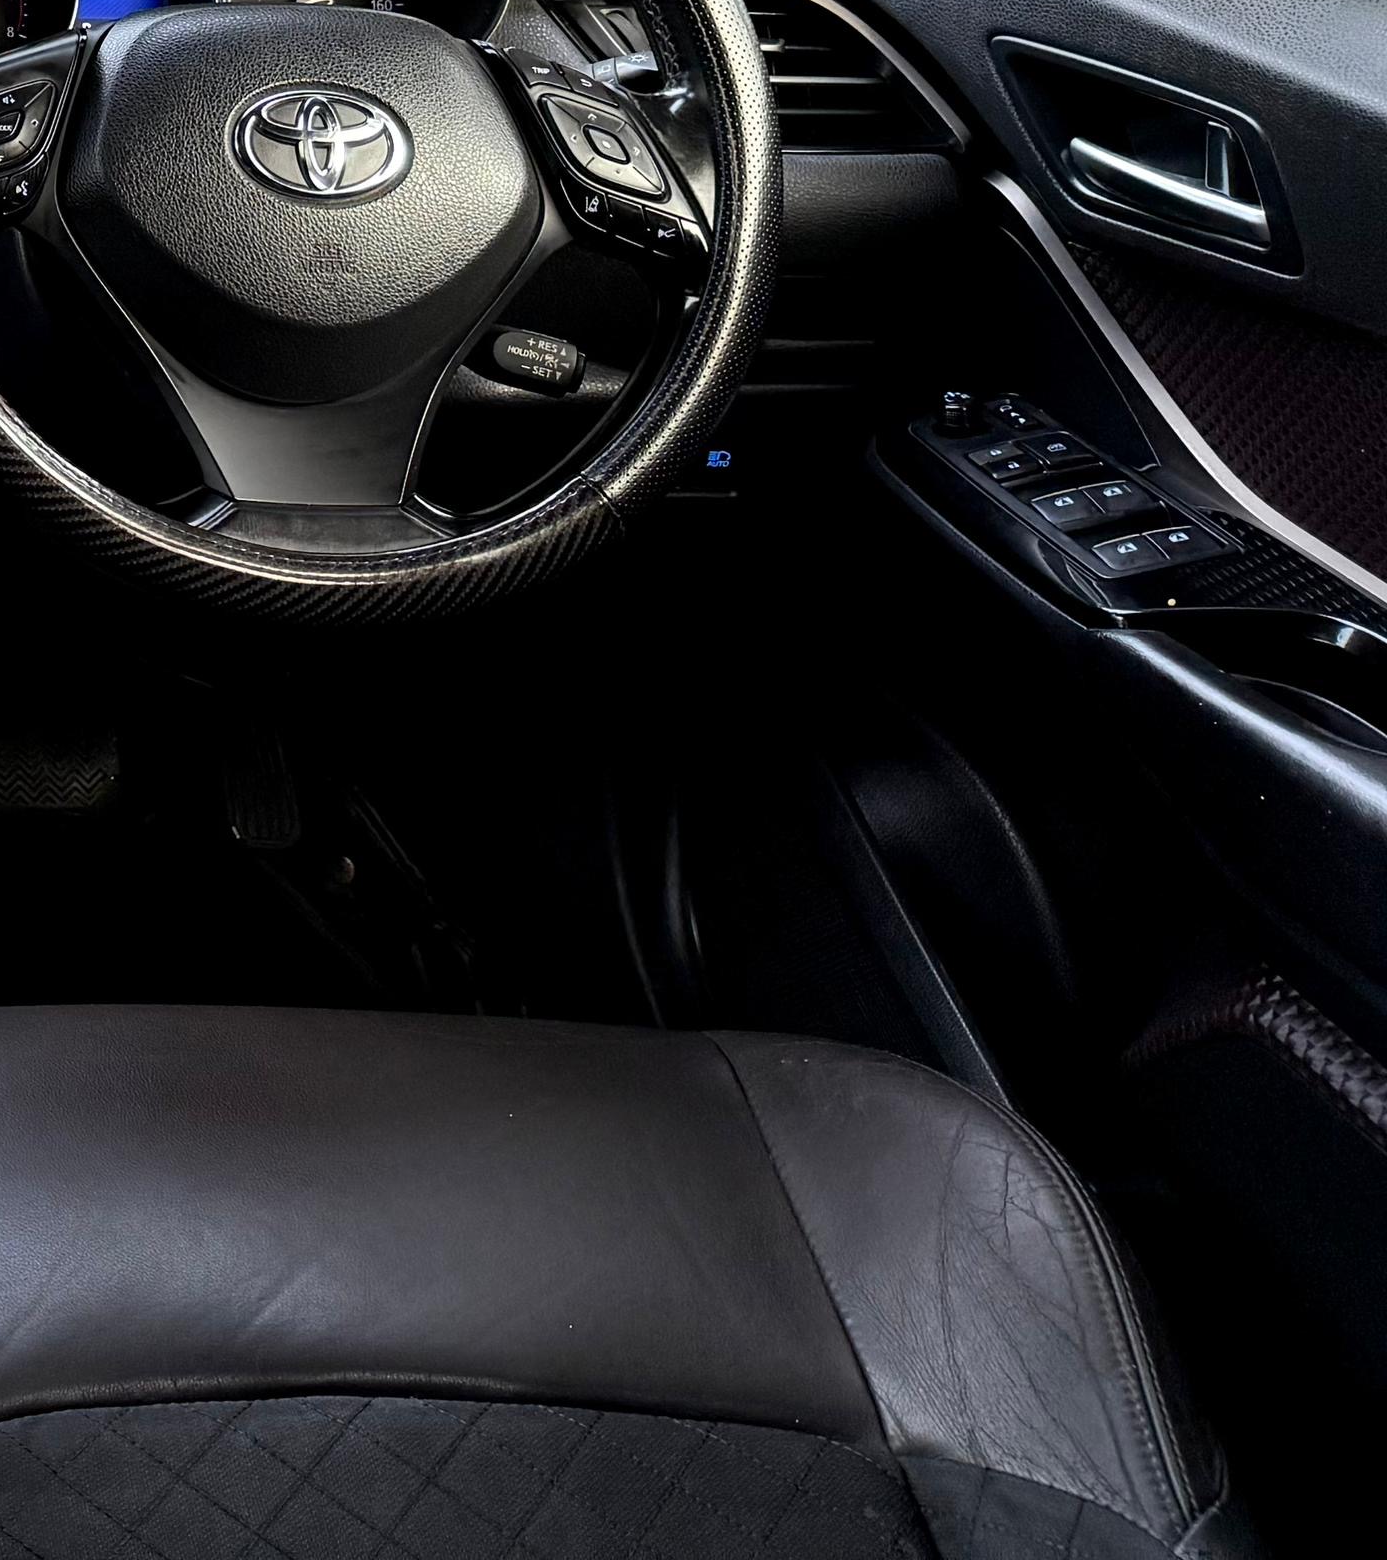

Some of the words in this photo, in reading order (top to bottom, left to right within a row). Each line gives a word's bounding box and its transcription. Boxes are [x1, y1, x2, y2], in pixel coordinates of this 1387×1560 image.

[370, 0, 393, 12] 160
[6, 26, 15, 38] 8
[507, 345, 529, 357] HOLD
[537, 339, 558, 353] RES
[532, 365, 553, 378] SET
[706, 460, 730, 468] AUTO
